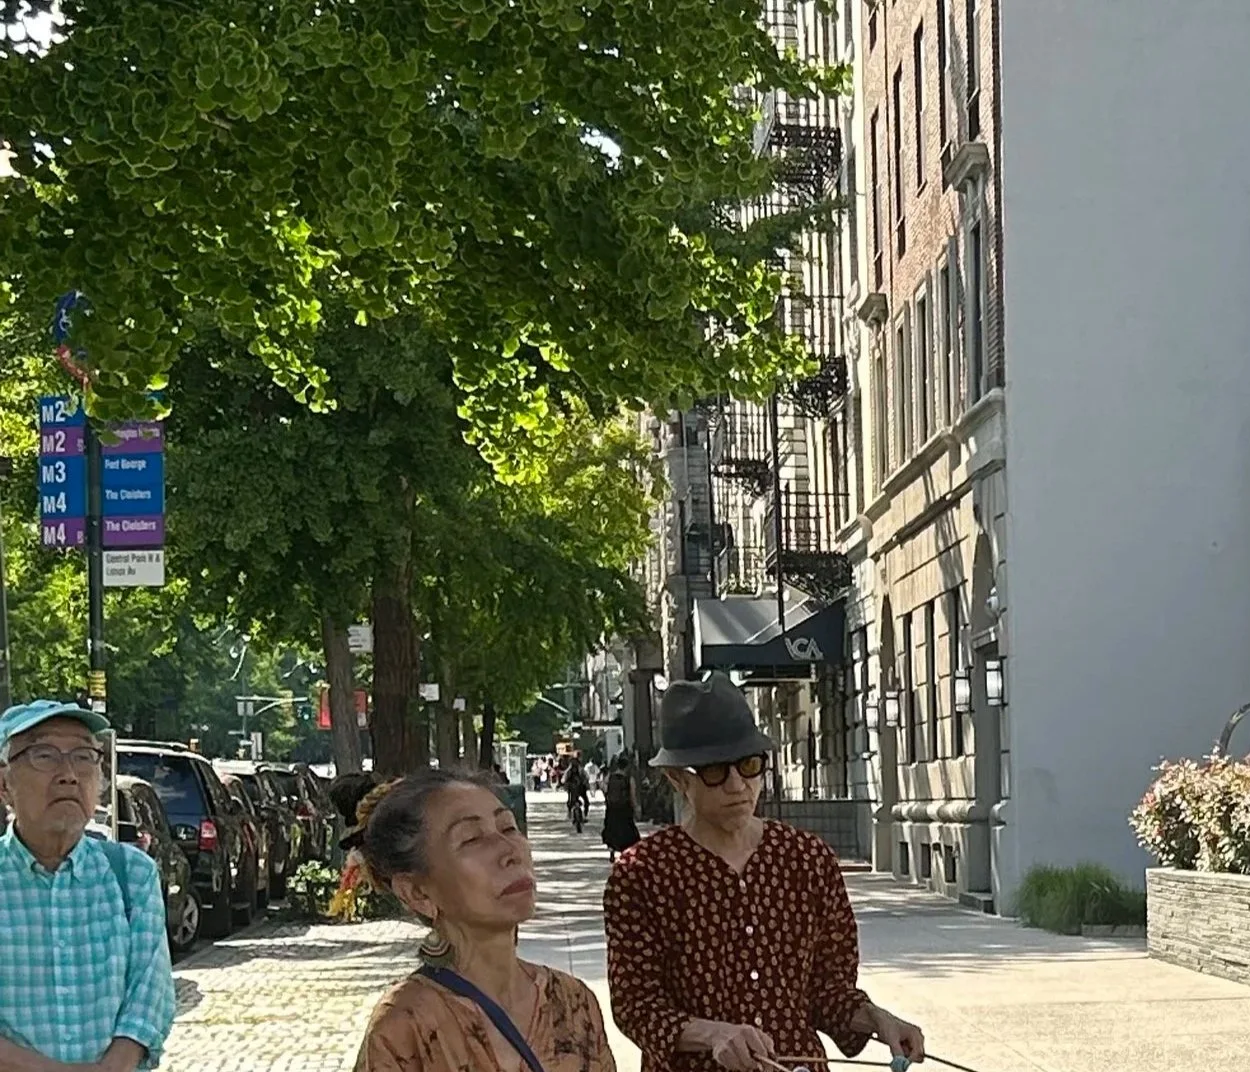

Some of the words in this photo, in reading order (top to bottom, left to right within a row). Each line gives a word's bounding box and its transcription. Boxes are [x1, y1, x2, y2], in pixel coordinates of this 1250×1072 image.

[42, 400, 66, 423] M2
[42, 430, 66, 453] M2
[42, 461, 67, 484] M3
[43, 491, 67, 514] M4
[43, 523, 66, 545] M4
[106, 521, 120, 532] The
